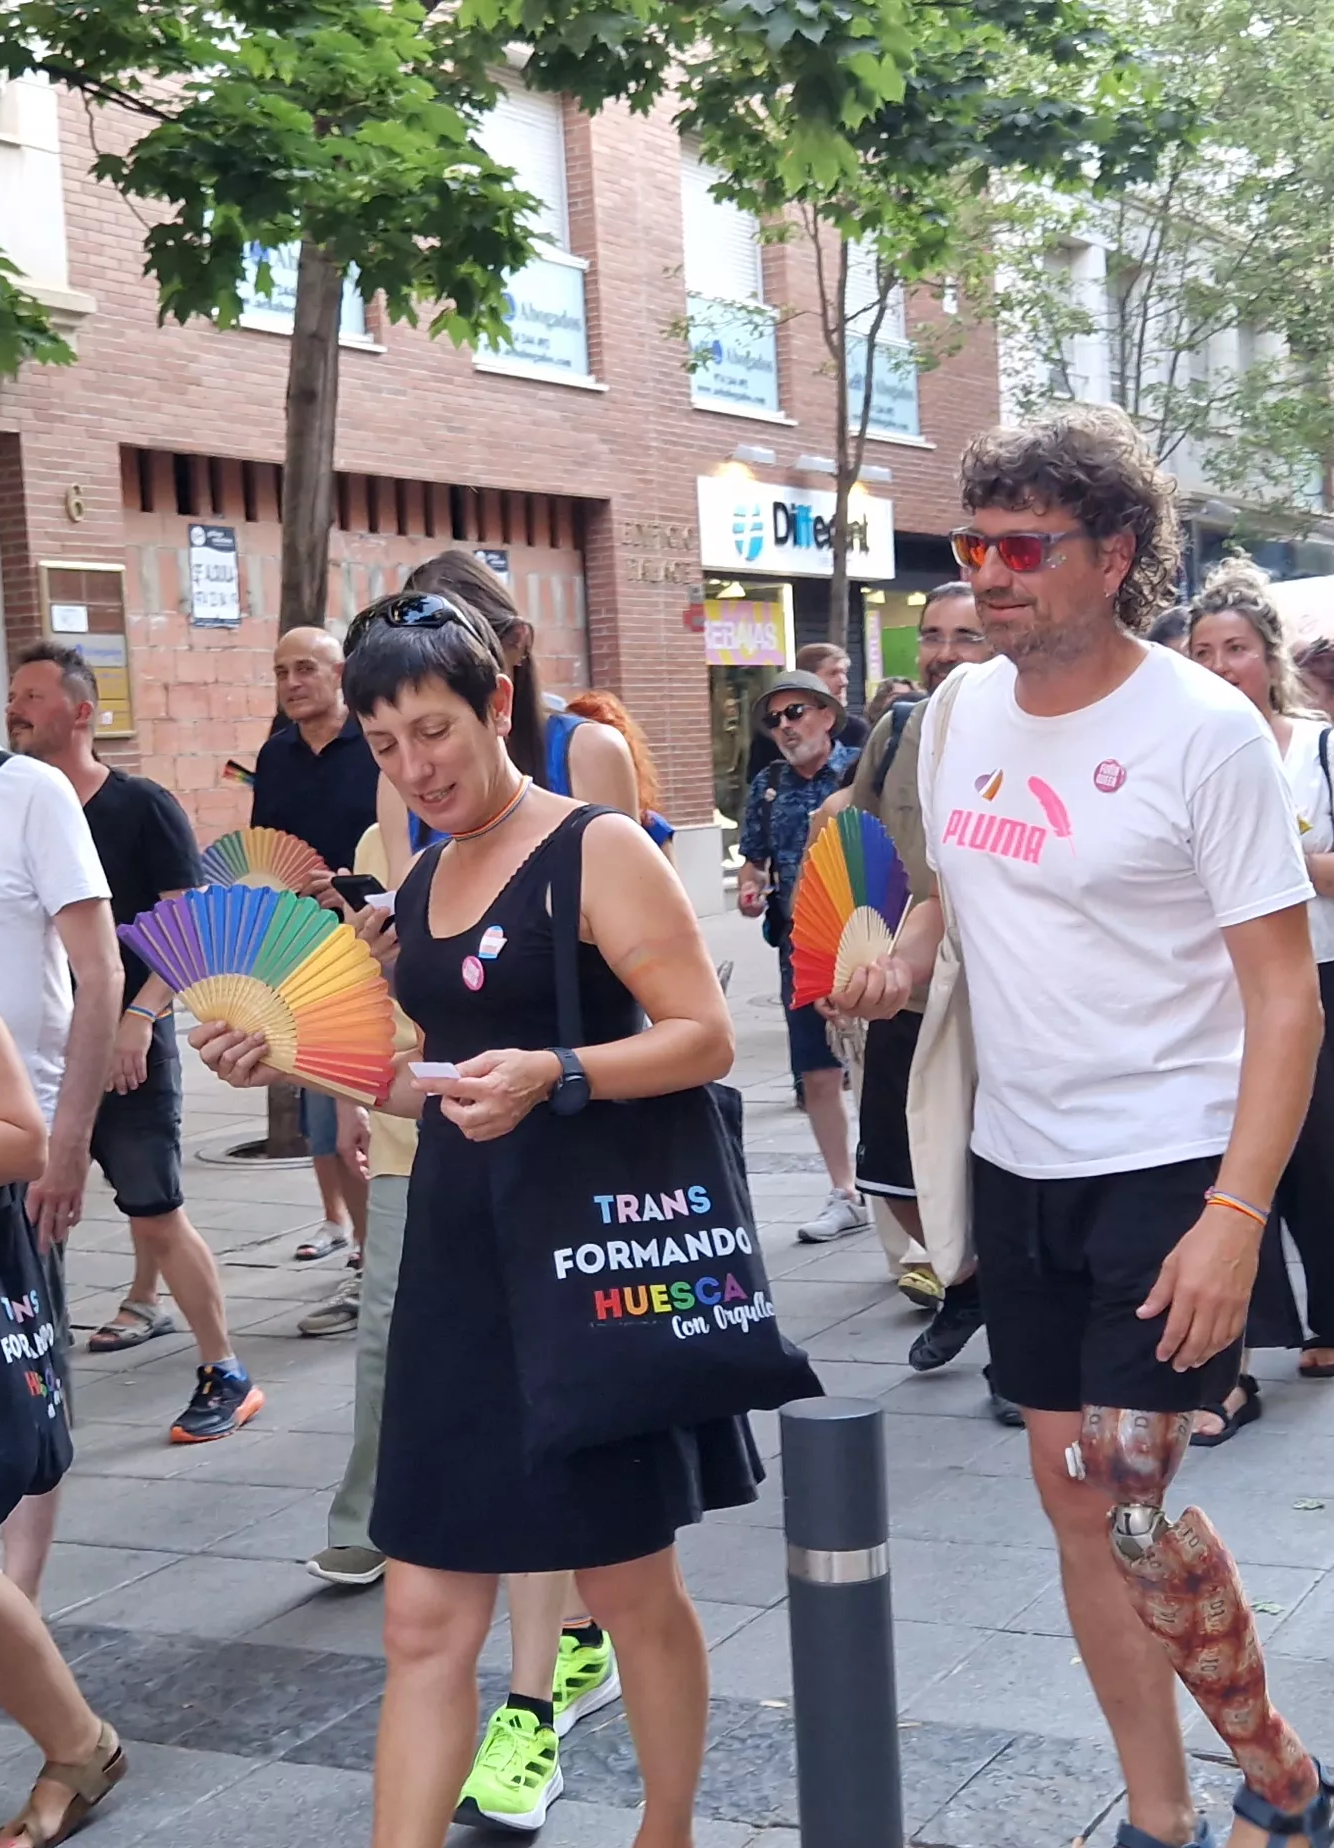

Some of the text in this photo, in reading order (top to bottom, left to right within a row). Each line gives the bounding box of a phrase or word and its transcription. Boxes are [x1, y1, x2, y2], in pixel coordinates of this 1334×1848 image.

[66, 484, 85, 523] 6
[773, 501, 870, 556] Differnt
[942, 809, 1047, 864] PLUMA
[594, 1185, 711, 1224] TRANS
[553, 1226, 753, 1279] FORMANDO
[594, 1273, 748, 1320] HUESCA
[671, 1314, 710, 1340] Con
